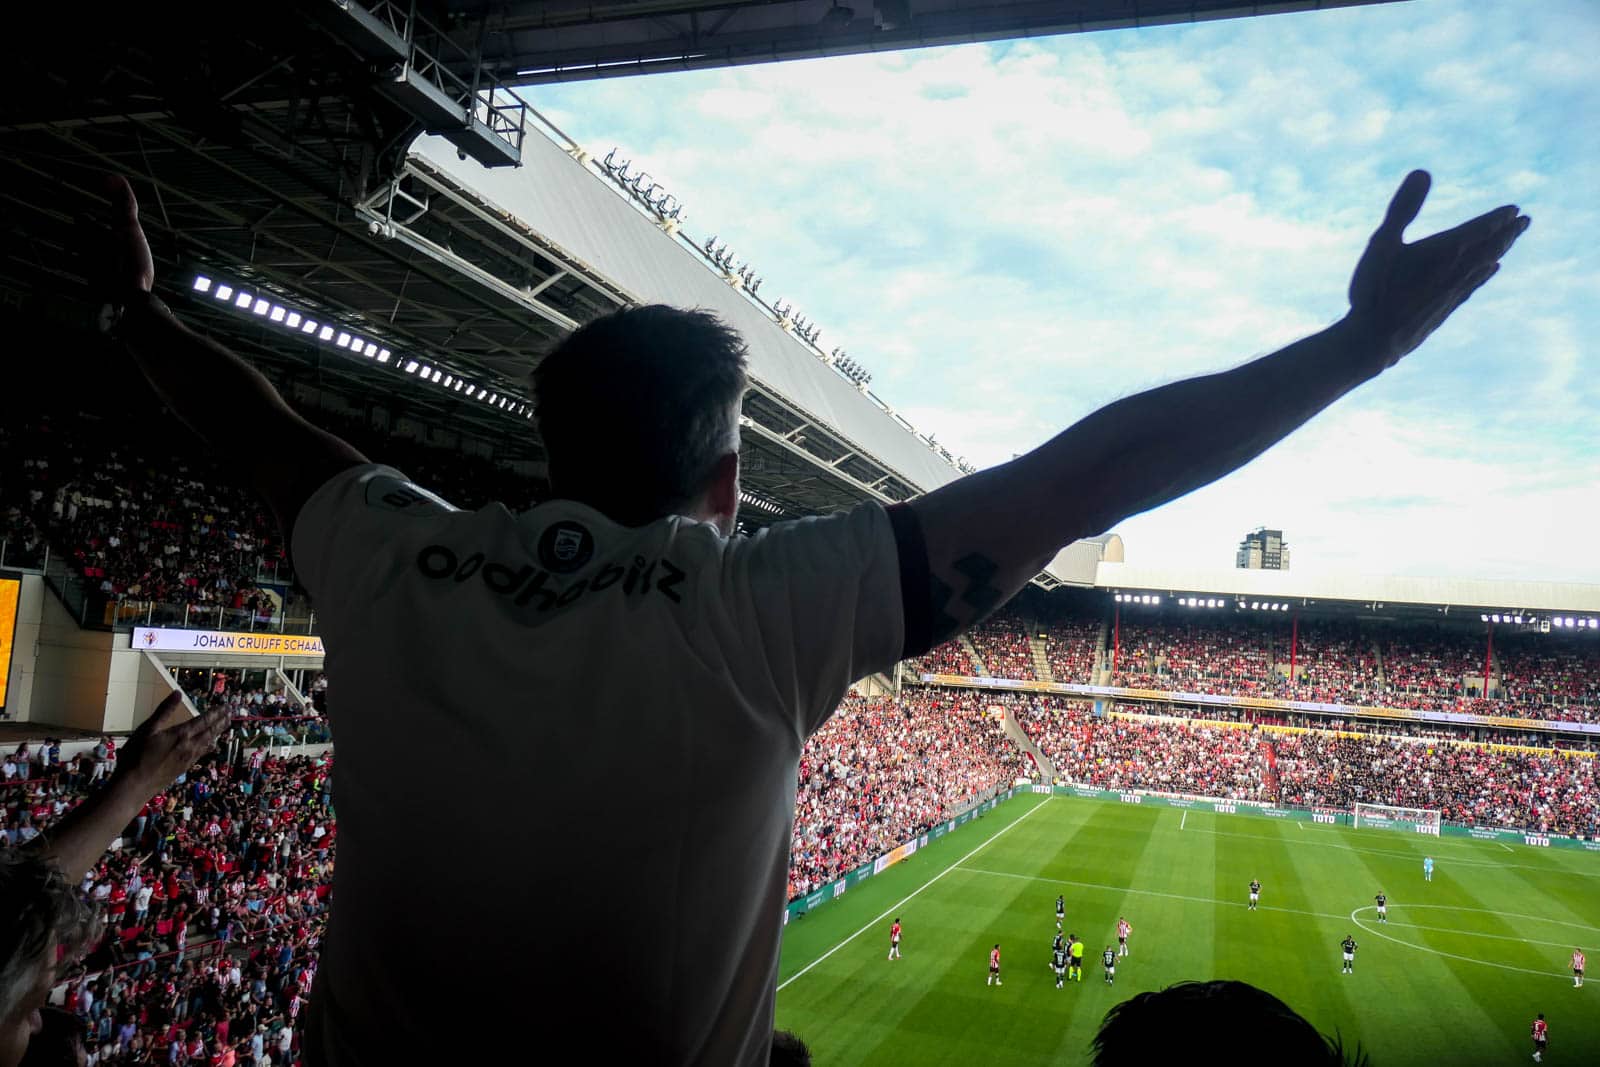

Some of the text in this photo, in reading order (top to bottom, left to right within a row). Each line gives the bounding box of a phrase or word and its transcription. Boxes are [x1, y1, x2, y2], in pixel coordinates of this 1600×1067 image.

[193, 634, 323, 652] JOHAN CRUIJFF SCHAAL
[1032, 785, 1051, 794] TOTO
[1120, 794, 1141, 804] TOTO
[1214, 804, 1236, 814] TOTO
[1312, 814, 1335, 824] TOTO
[1415, 824, 1438, 835] TOTO
[1524, 835, 1550, 847] TOTO
